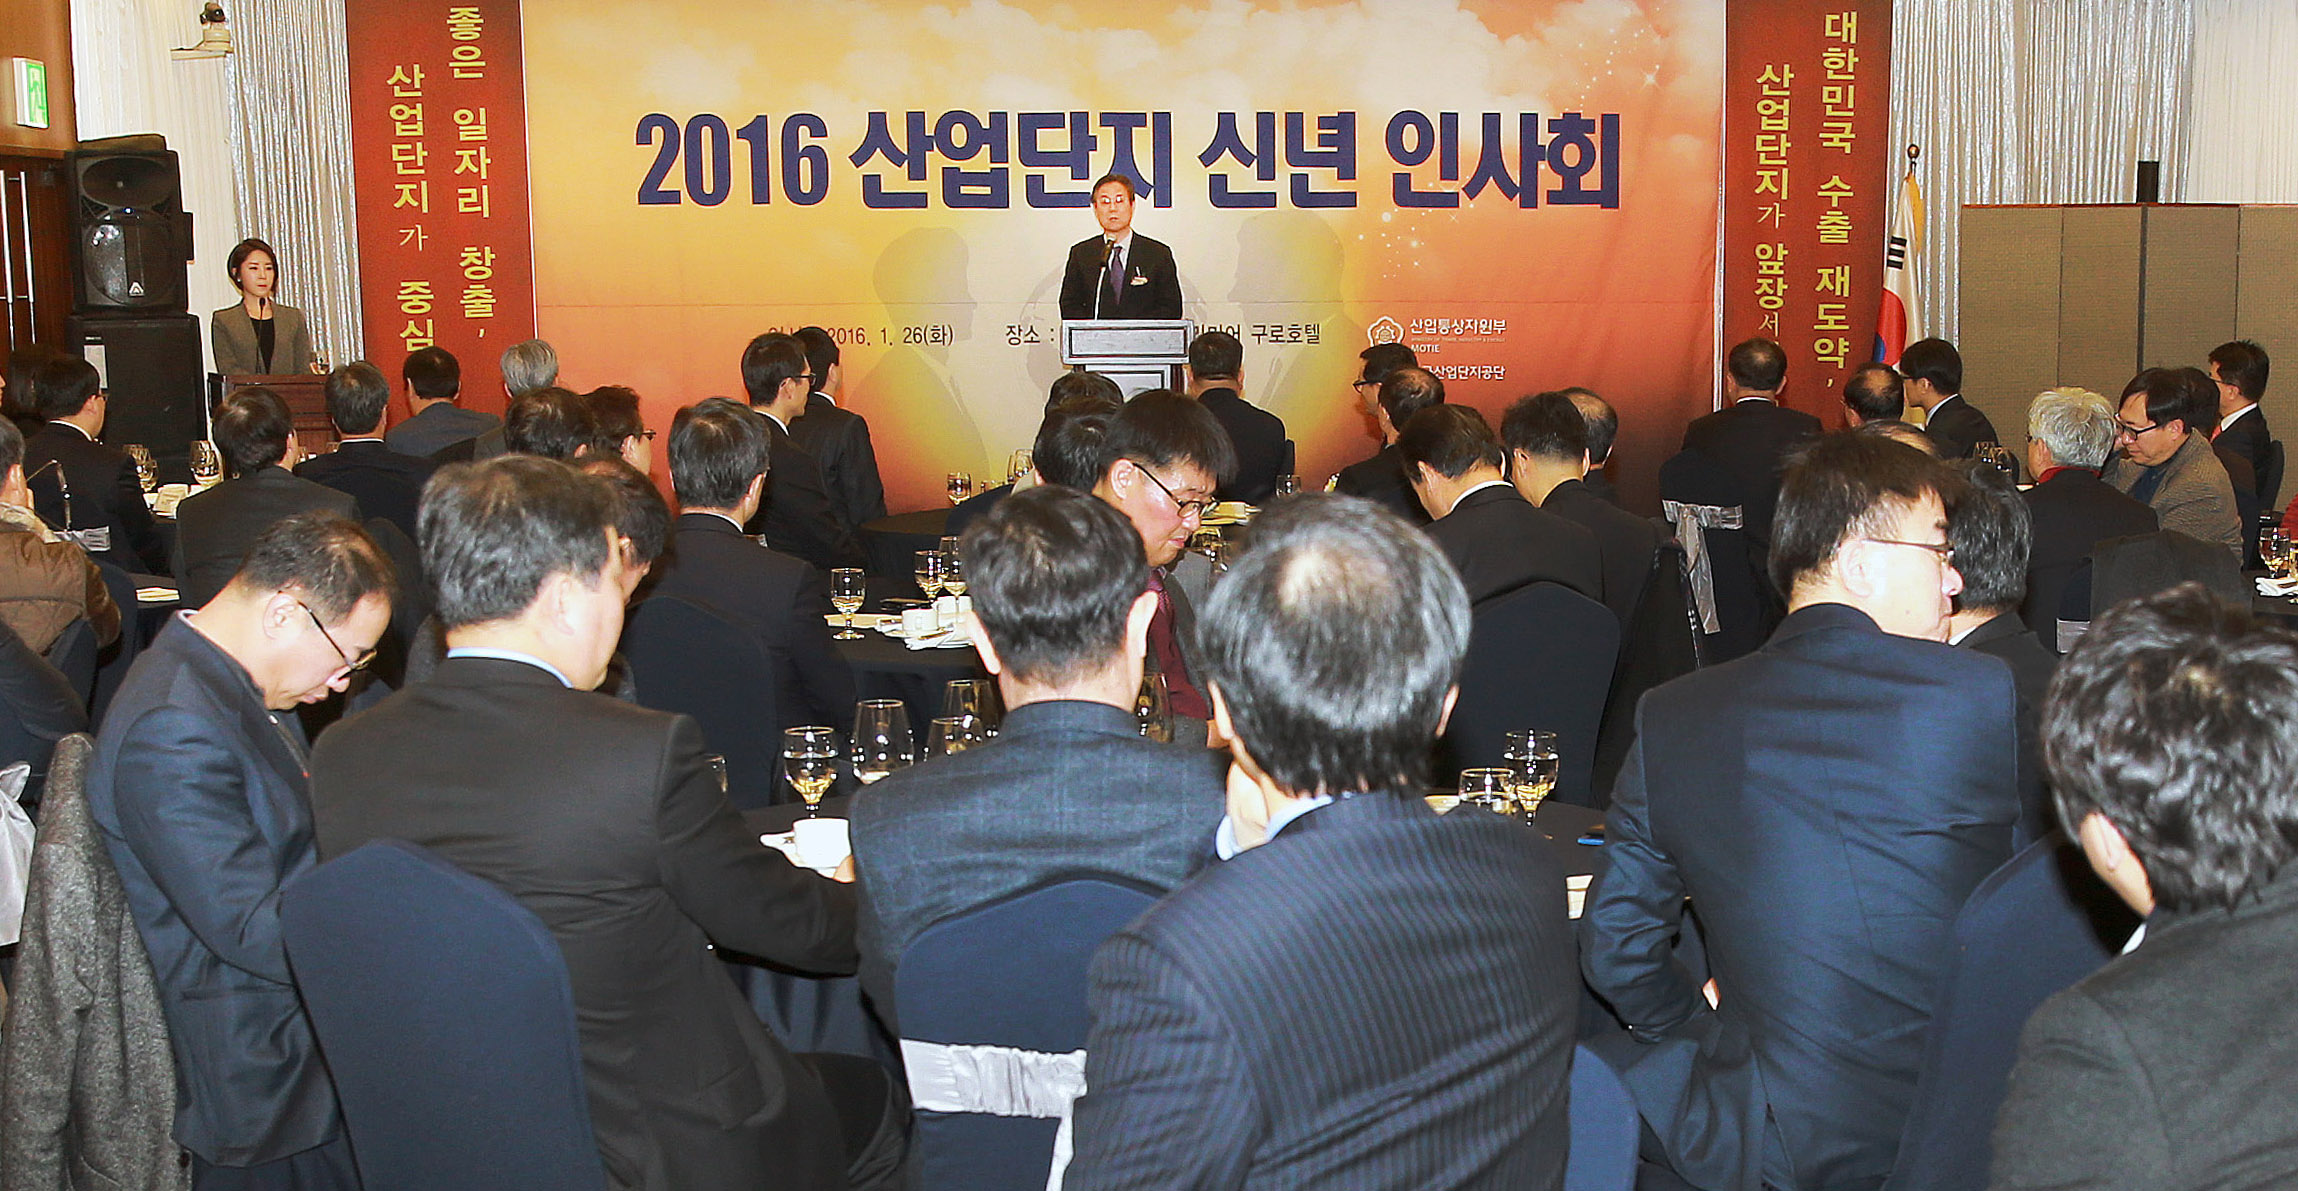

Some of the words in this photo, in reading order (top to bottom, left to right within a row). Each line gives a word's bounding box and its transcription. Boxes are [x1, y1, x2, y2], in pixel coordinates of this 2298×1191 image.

[446, 6, 486, 79] 좋은
[1818, 11, 1860, 155] 대한민국
[386, 63, 429, 252] 산업단지가
[453, 107, 491, 218] 일자리
[635, 113, 829, 206] 2016
[849, 110, 1173, 209] 산업단지
[1198, 111, 1357, 208] 신년
[1385, 109, 1620, 209] 인사회
[1754, 63, 1796, 229] 산업단지가
[1815, 175, 1854, 244] 수출
[397, 280, 434, 352] 중심
[1409, 318, 1507, 335] 산업통상자원부
[1754, 243, 1789, 346] 앞장서
[903, 325, 954, 346] 26(화)
[1005, 324, 1041, 346] 장소
[1250, 323, 1321, 345] 구로호텔
[1411, 344, 1440, 353] MOTIE
